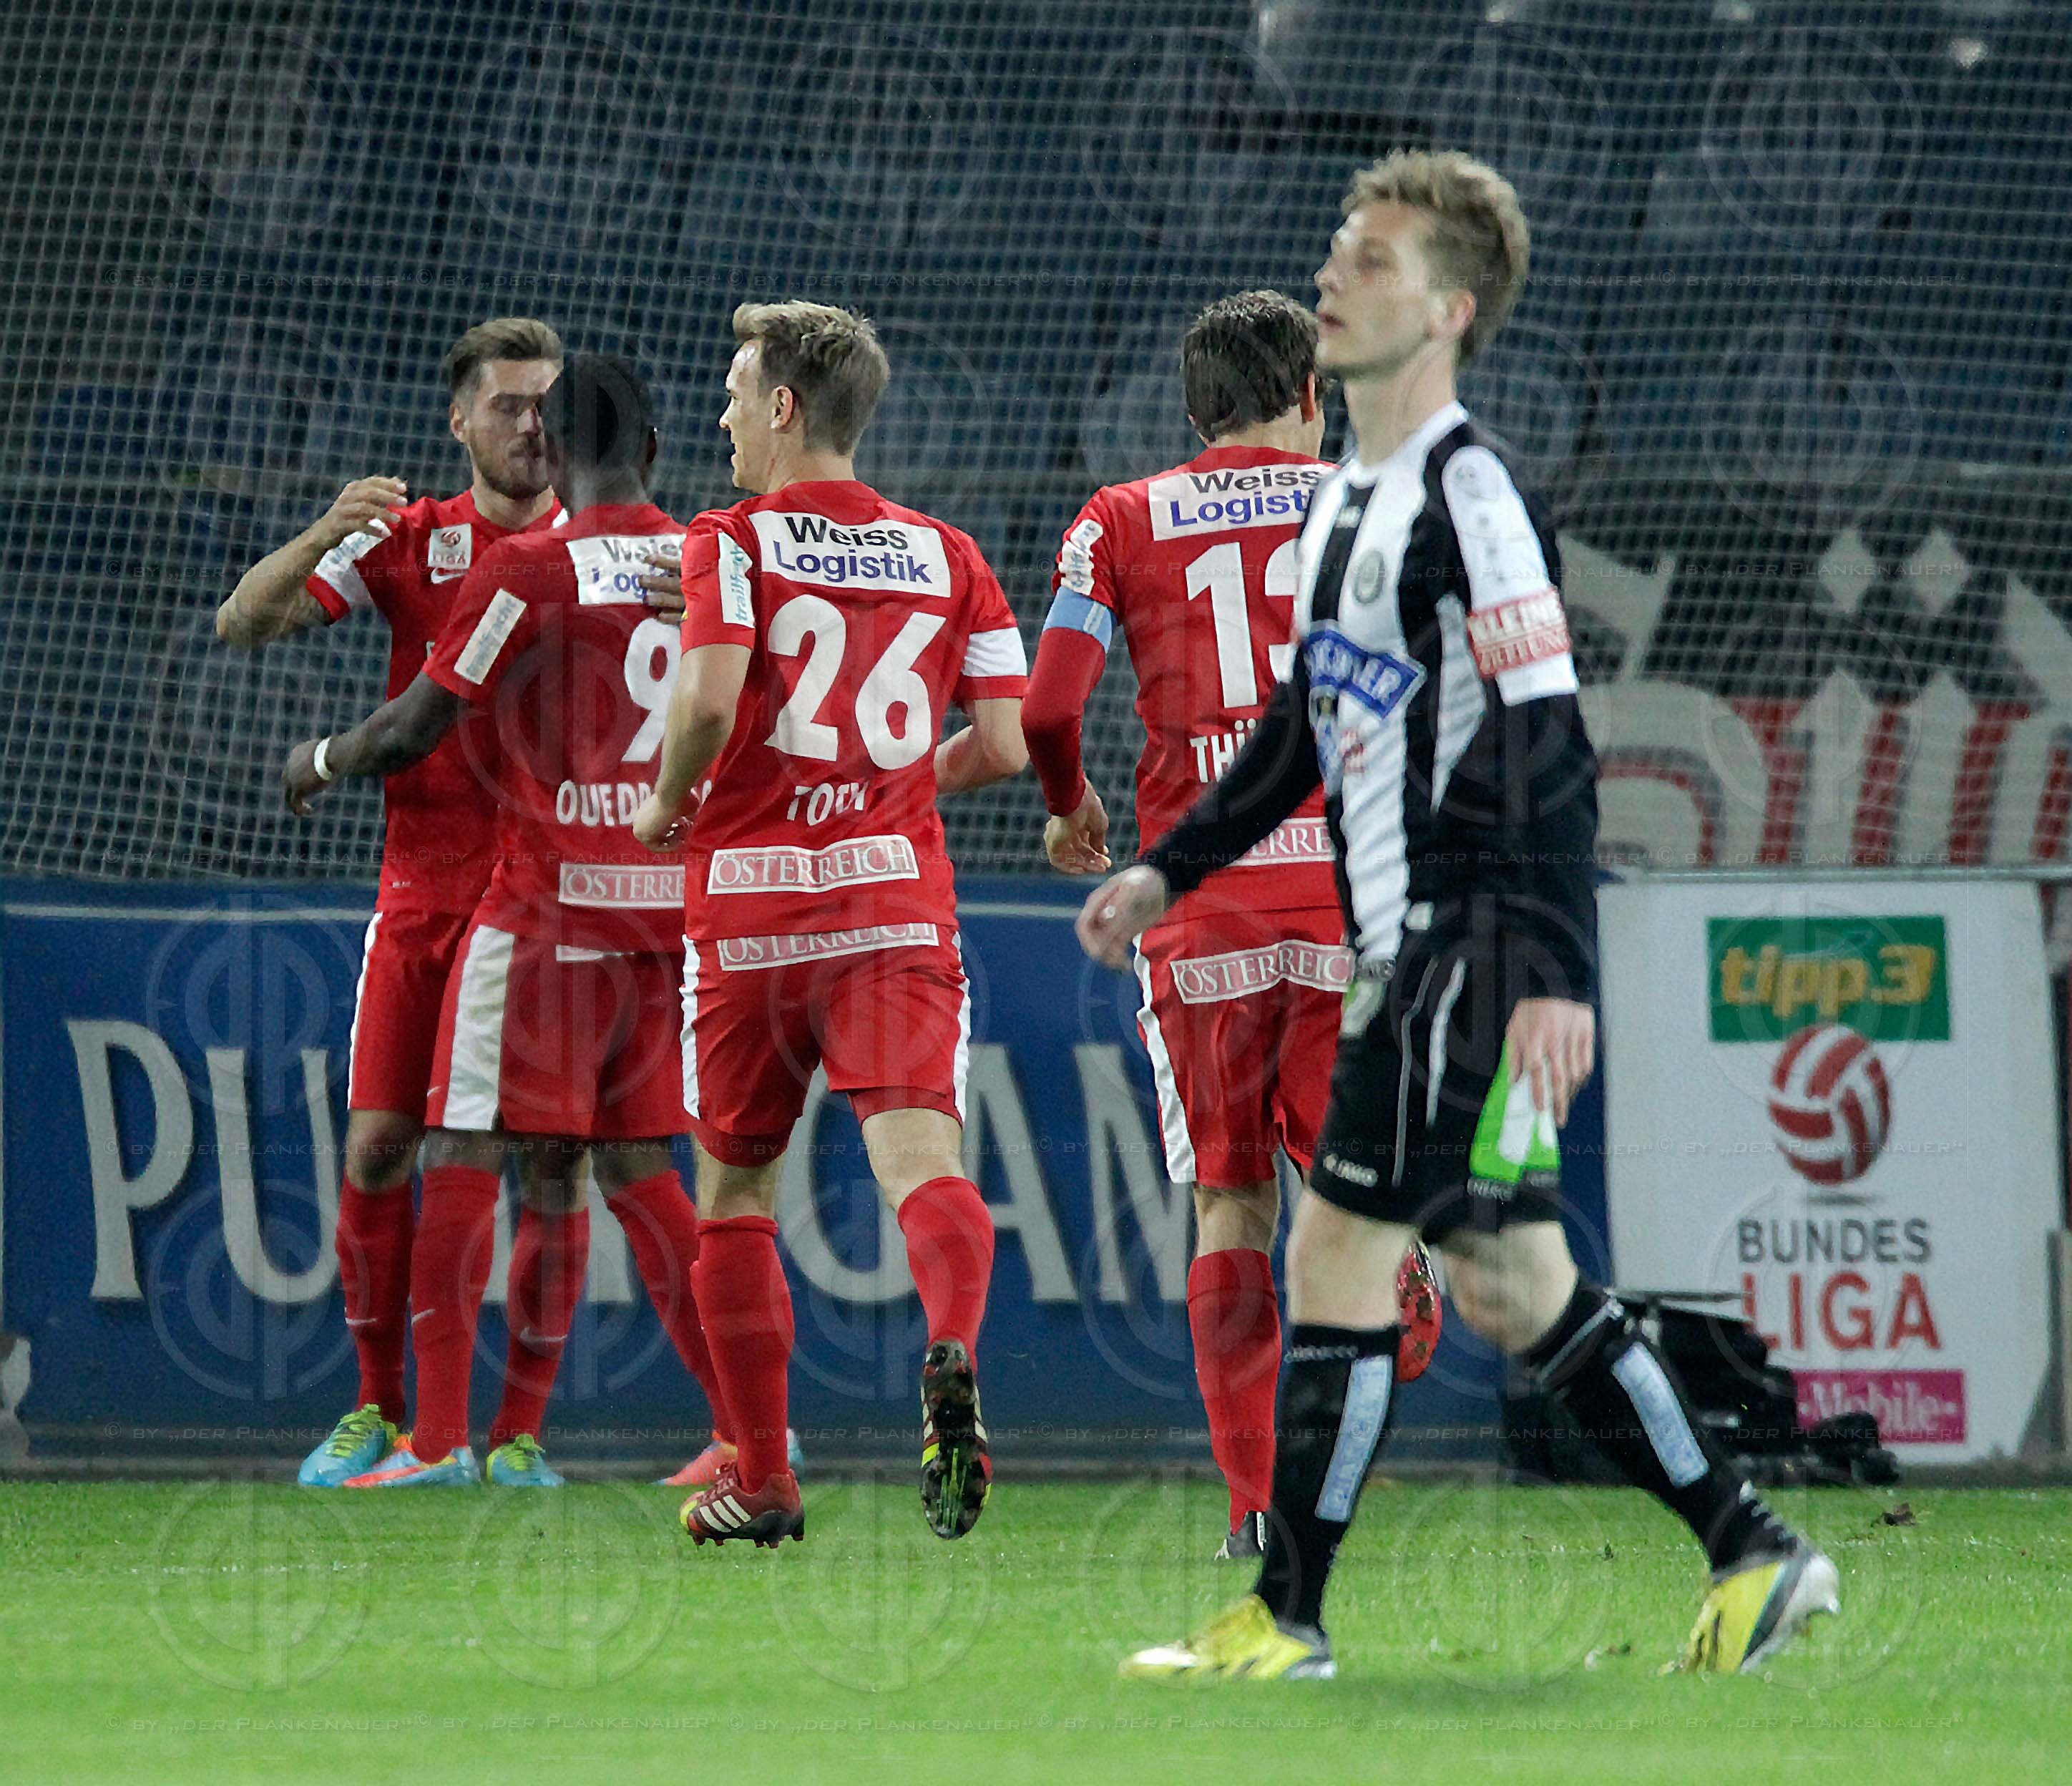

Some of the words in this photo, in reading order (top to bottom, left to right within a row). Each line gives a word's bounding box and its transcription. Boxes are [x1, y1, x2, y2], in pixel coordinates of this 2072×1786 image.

[1189, 468, 1321, 494] Weiss
[784, 517, 908, 550] Weiss
[773, 540, 933, 582] Logistik
[623, 617, 683, 761] 9
[764, 594, 947, 770] 26
[715, 839, 912, 886] ÖSTERREICH
[1180, 947, 1351, 995] ÖSTERREIC
[1739, 1219, 1930, 1264] BUNDES
[1741, 1272, 1942, 1351] LIGA
